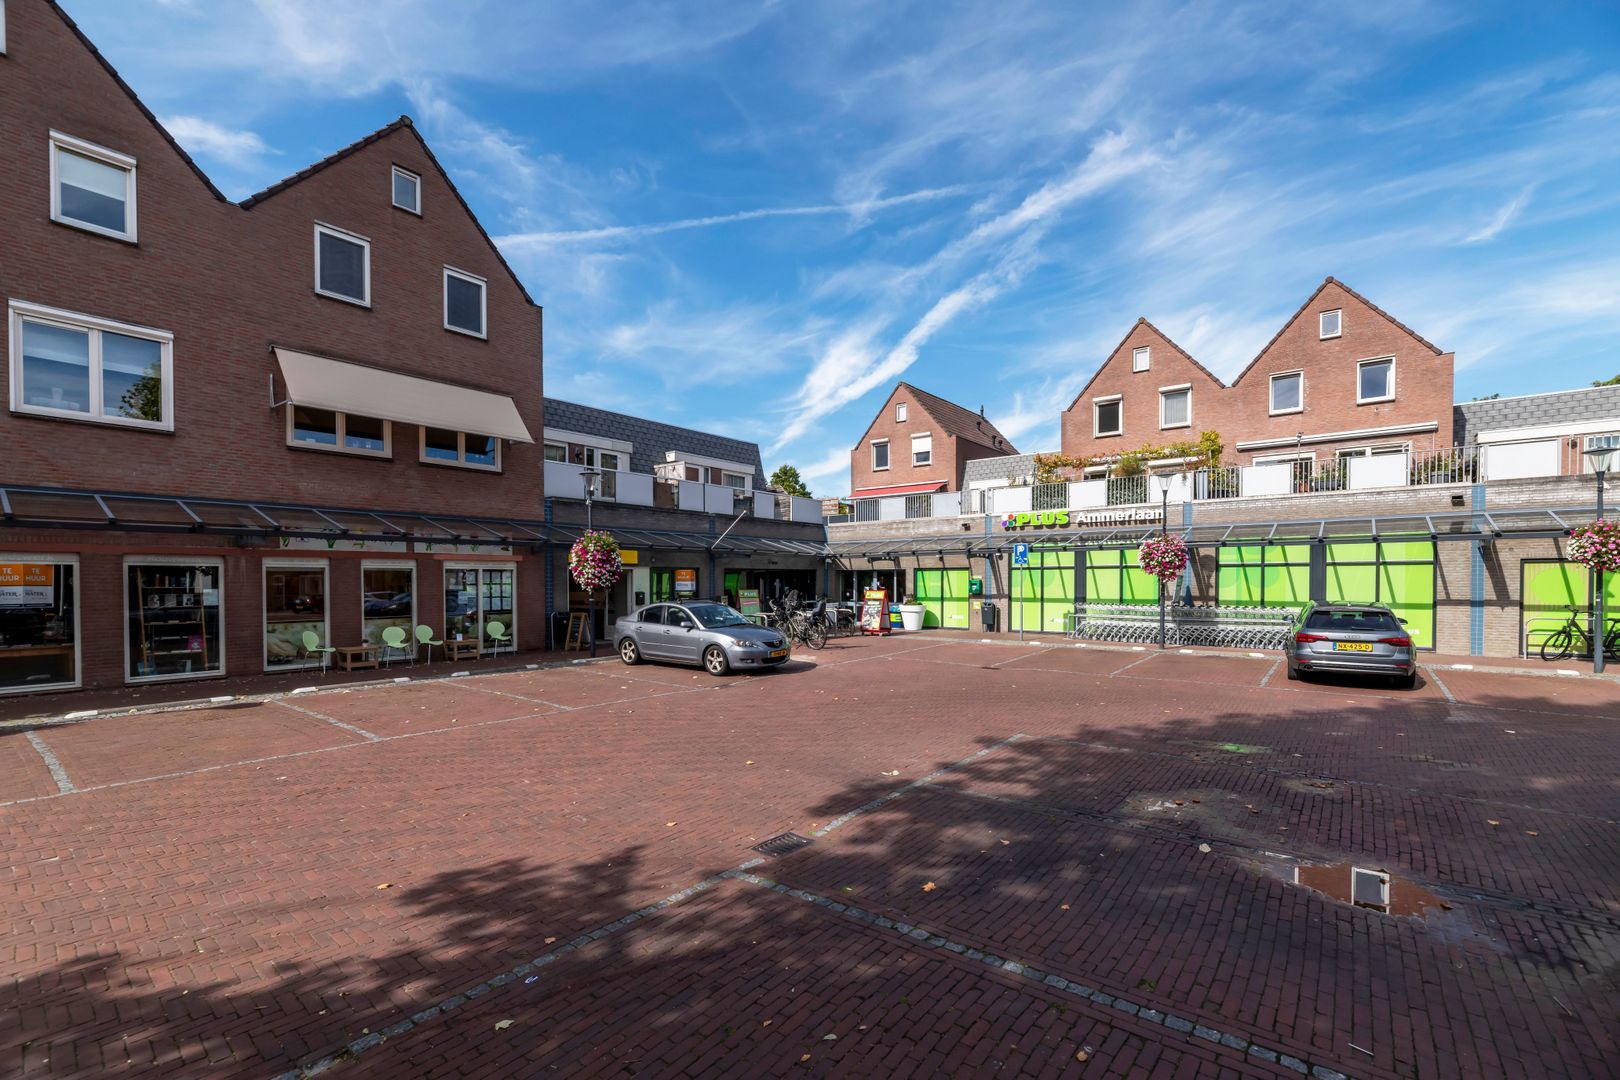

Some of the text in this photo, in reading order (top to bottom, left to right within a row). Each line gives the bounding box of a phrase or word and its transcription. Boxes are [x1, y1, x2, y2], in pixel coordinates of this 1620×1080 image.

[1015, 508, 1164, 527] PLUS Ammerlaan
[1016, 546, 1025, 556] P
